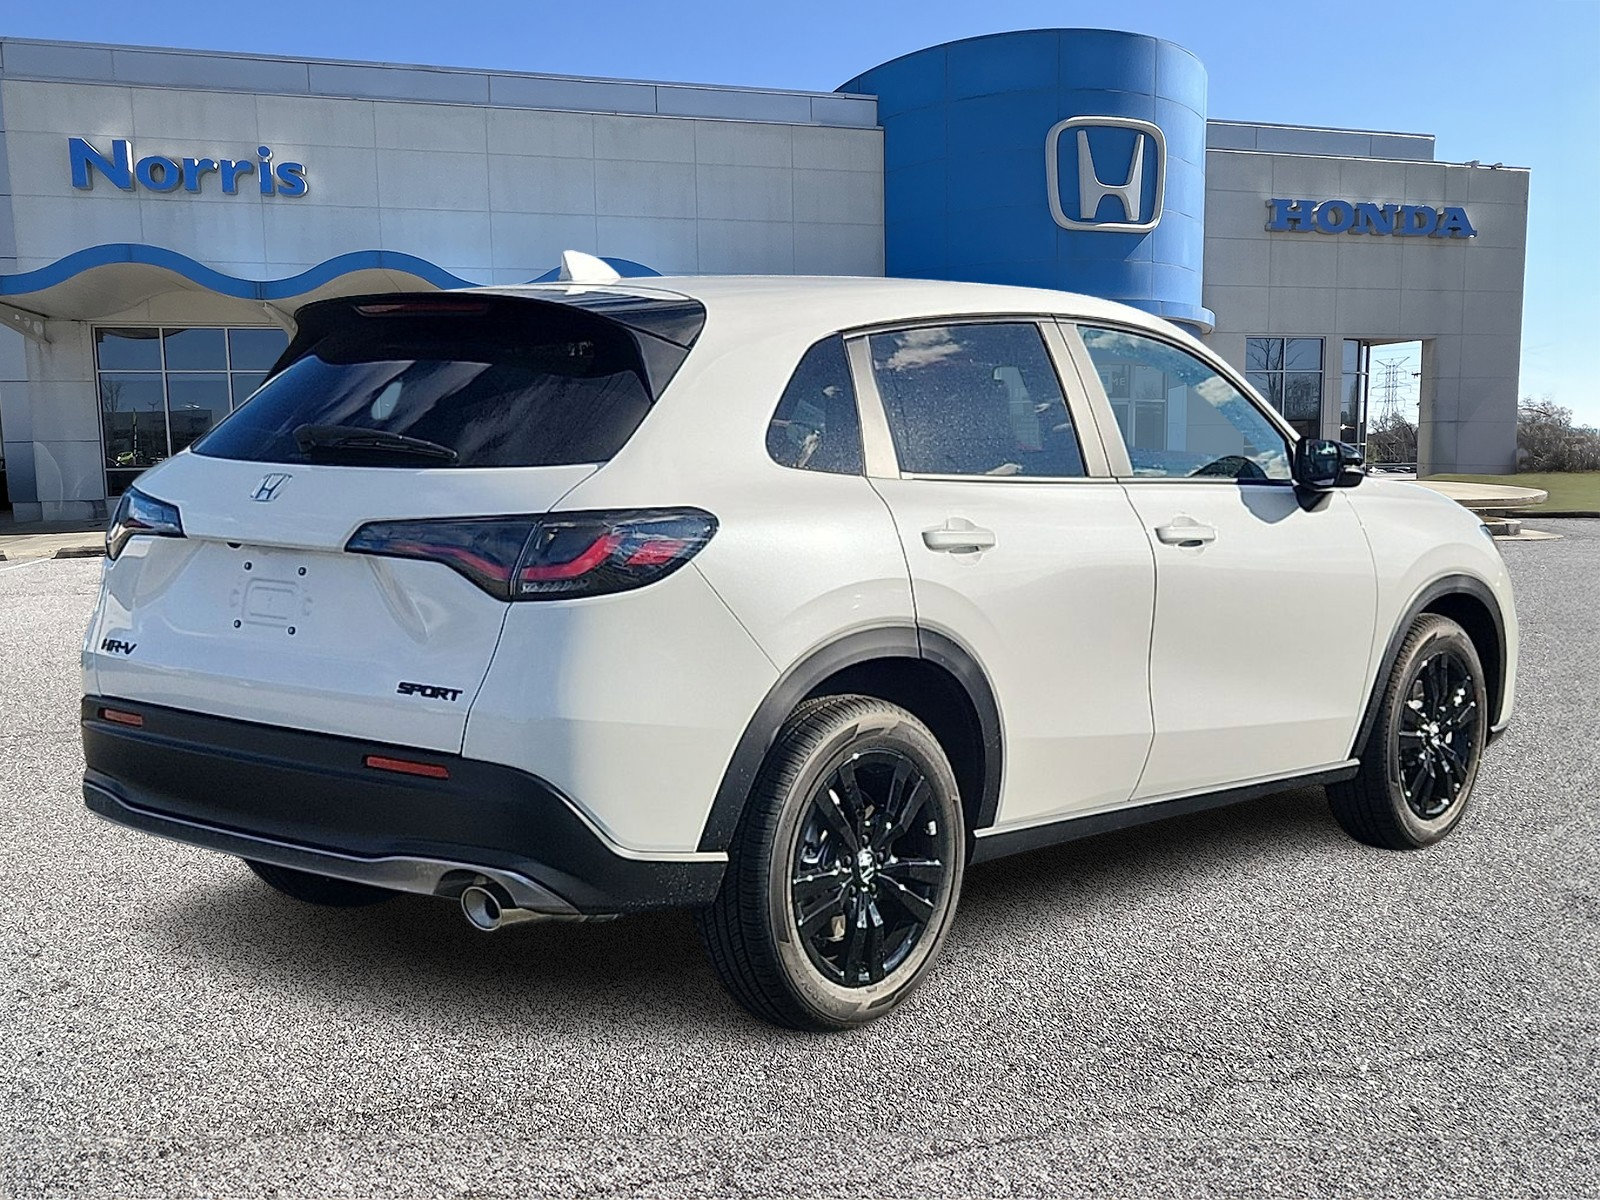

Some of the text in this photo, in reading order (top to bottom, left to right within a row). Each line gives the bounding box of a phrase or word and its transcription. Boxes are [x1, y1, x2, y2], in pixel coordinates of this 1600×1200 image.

[68, 137, 308, 197] Norris
[1265, 198, 1478, 239] HONDA
[101, 638, 138, 655] HR-V
[396, 681, 464, 702] SPORT
